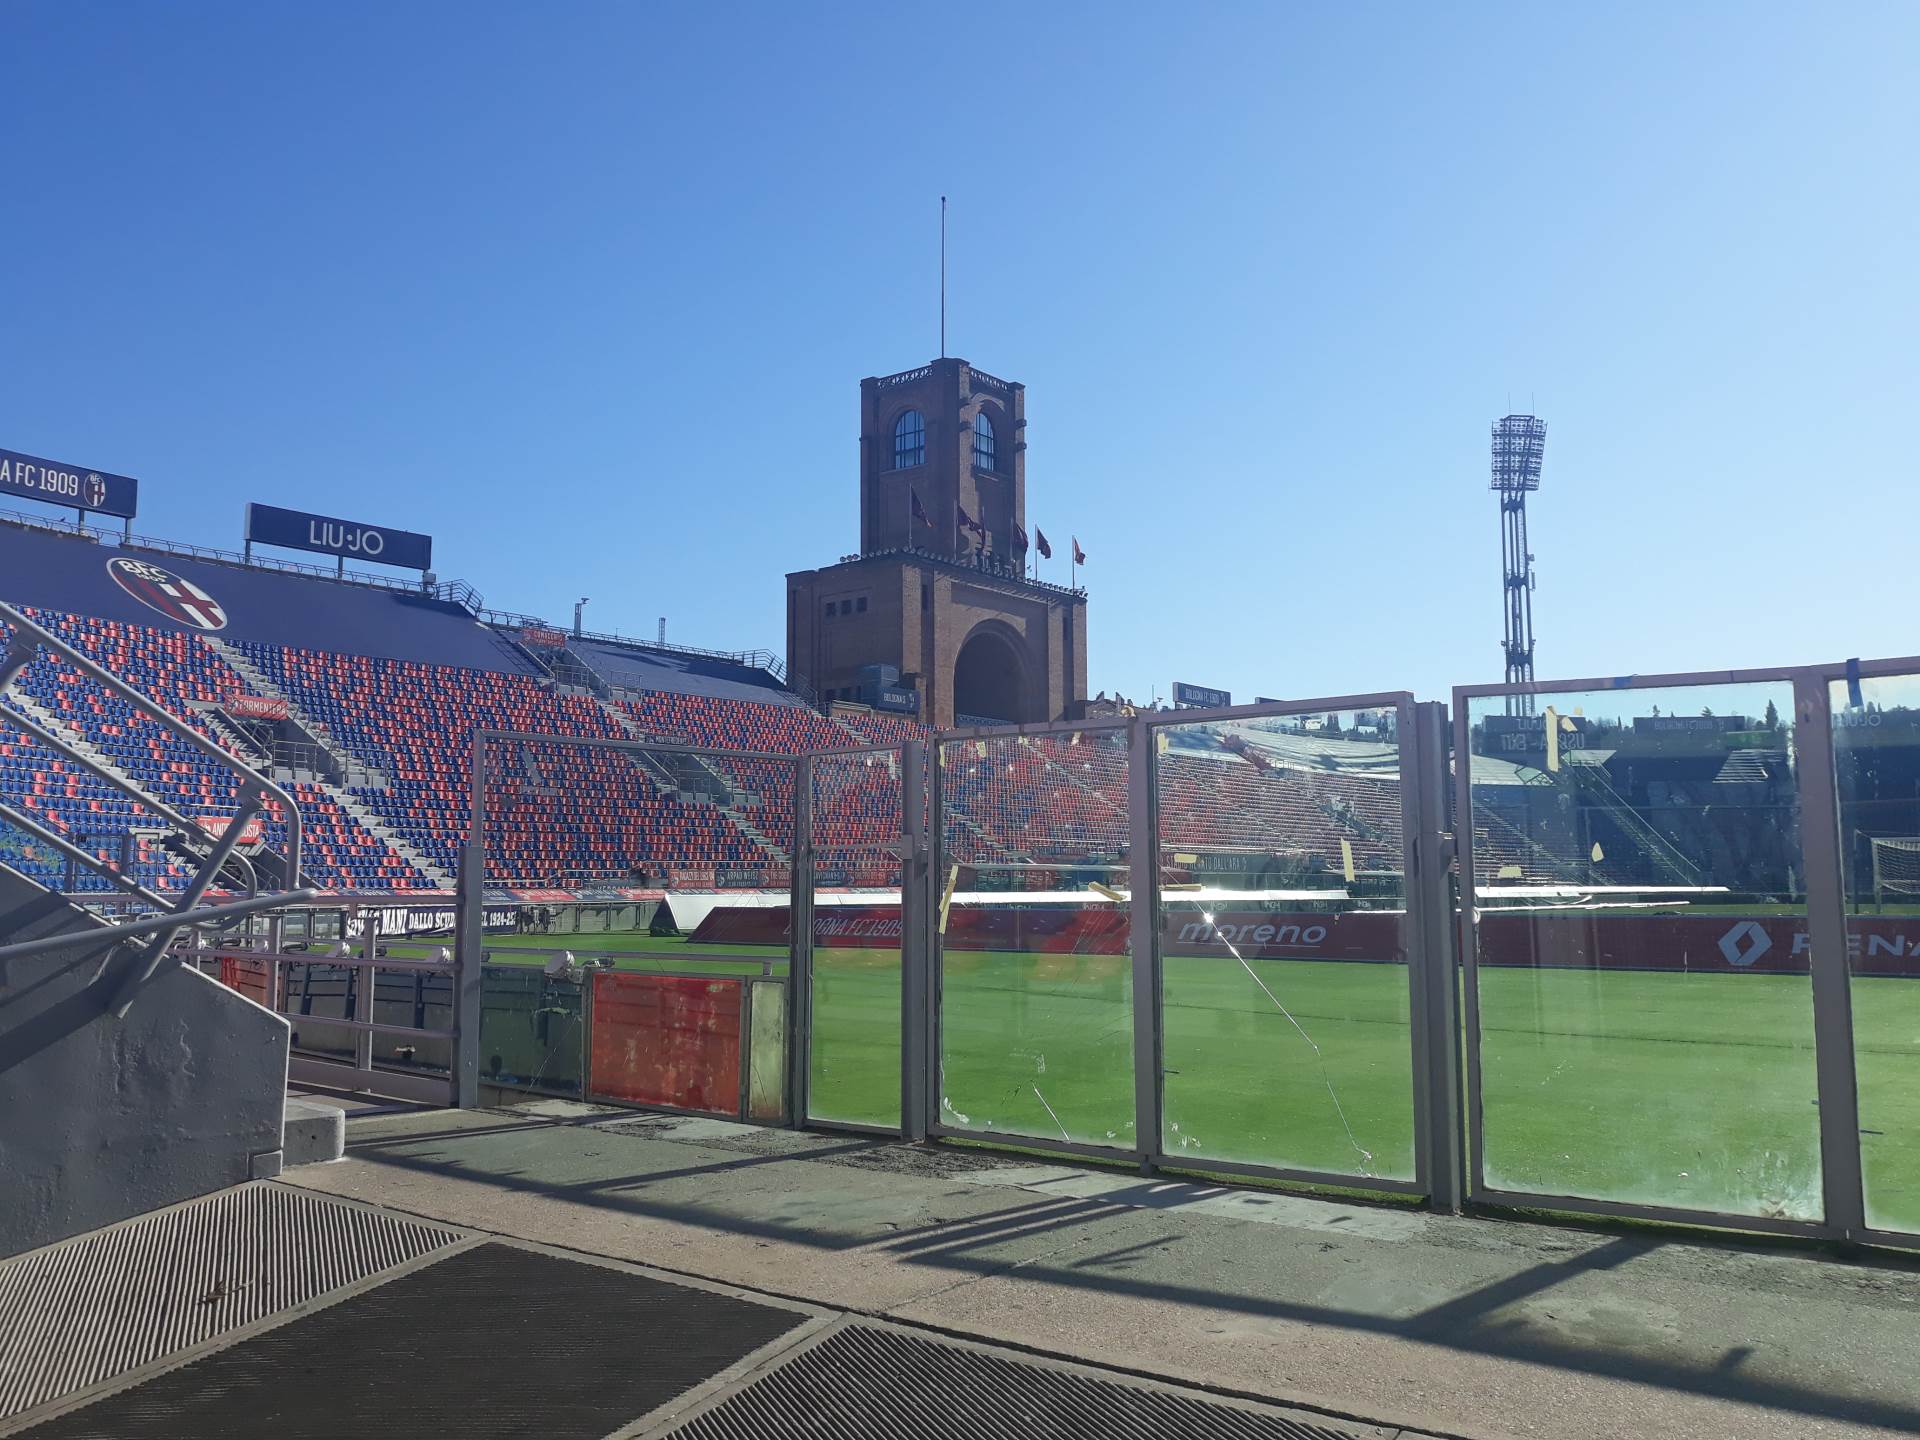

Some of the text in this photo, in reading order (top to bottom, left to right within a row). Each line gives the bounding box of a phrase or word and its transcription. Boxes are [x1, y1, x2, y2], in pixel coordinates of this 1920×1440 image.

[15, 462, 36, 487] FC
[38, 467, 79, 496] 1909
[117, 559, 168, 579] BFC
[212, 822, 231, 835] AND
[381, 908, 408, 935] MANI
[408, 912, 433, 930] DALLO
[434, 911, 457, 929] SCUD
[1178, 922, 1327, 943] moreno
